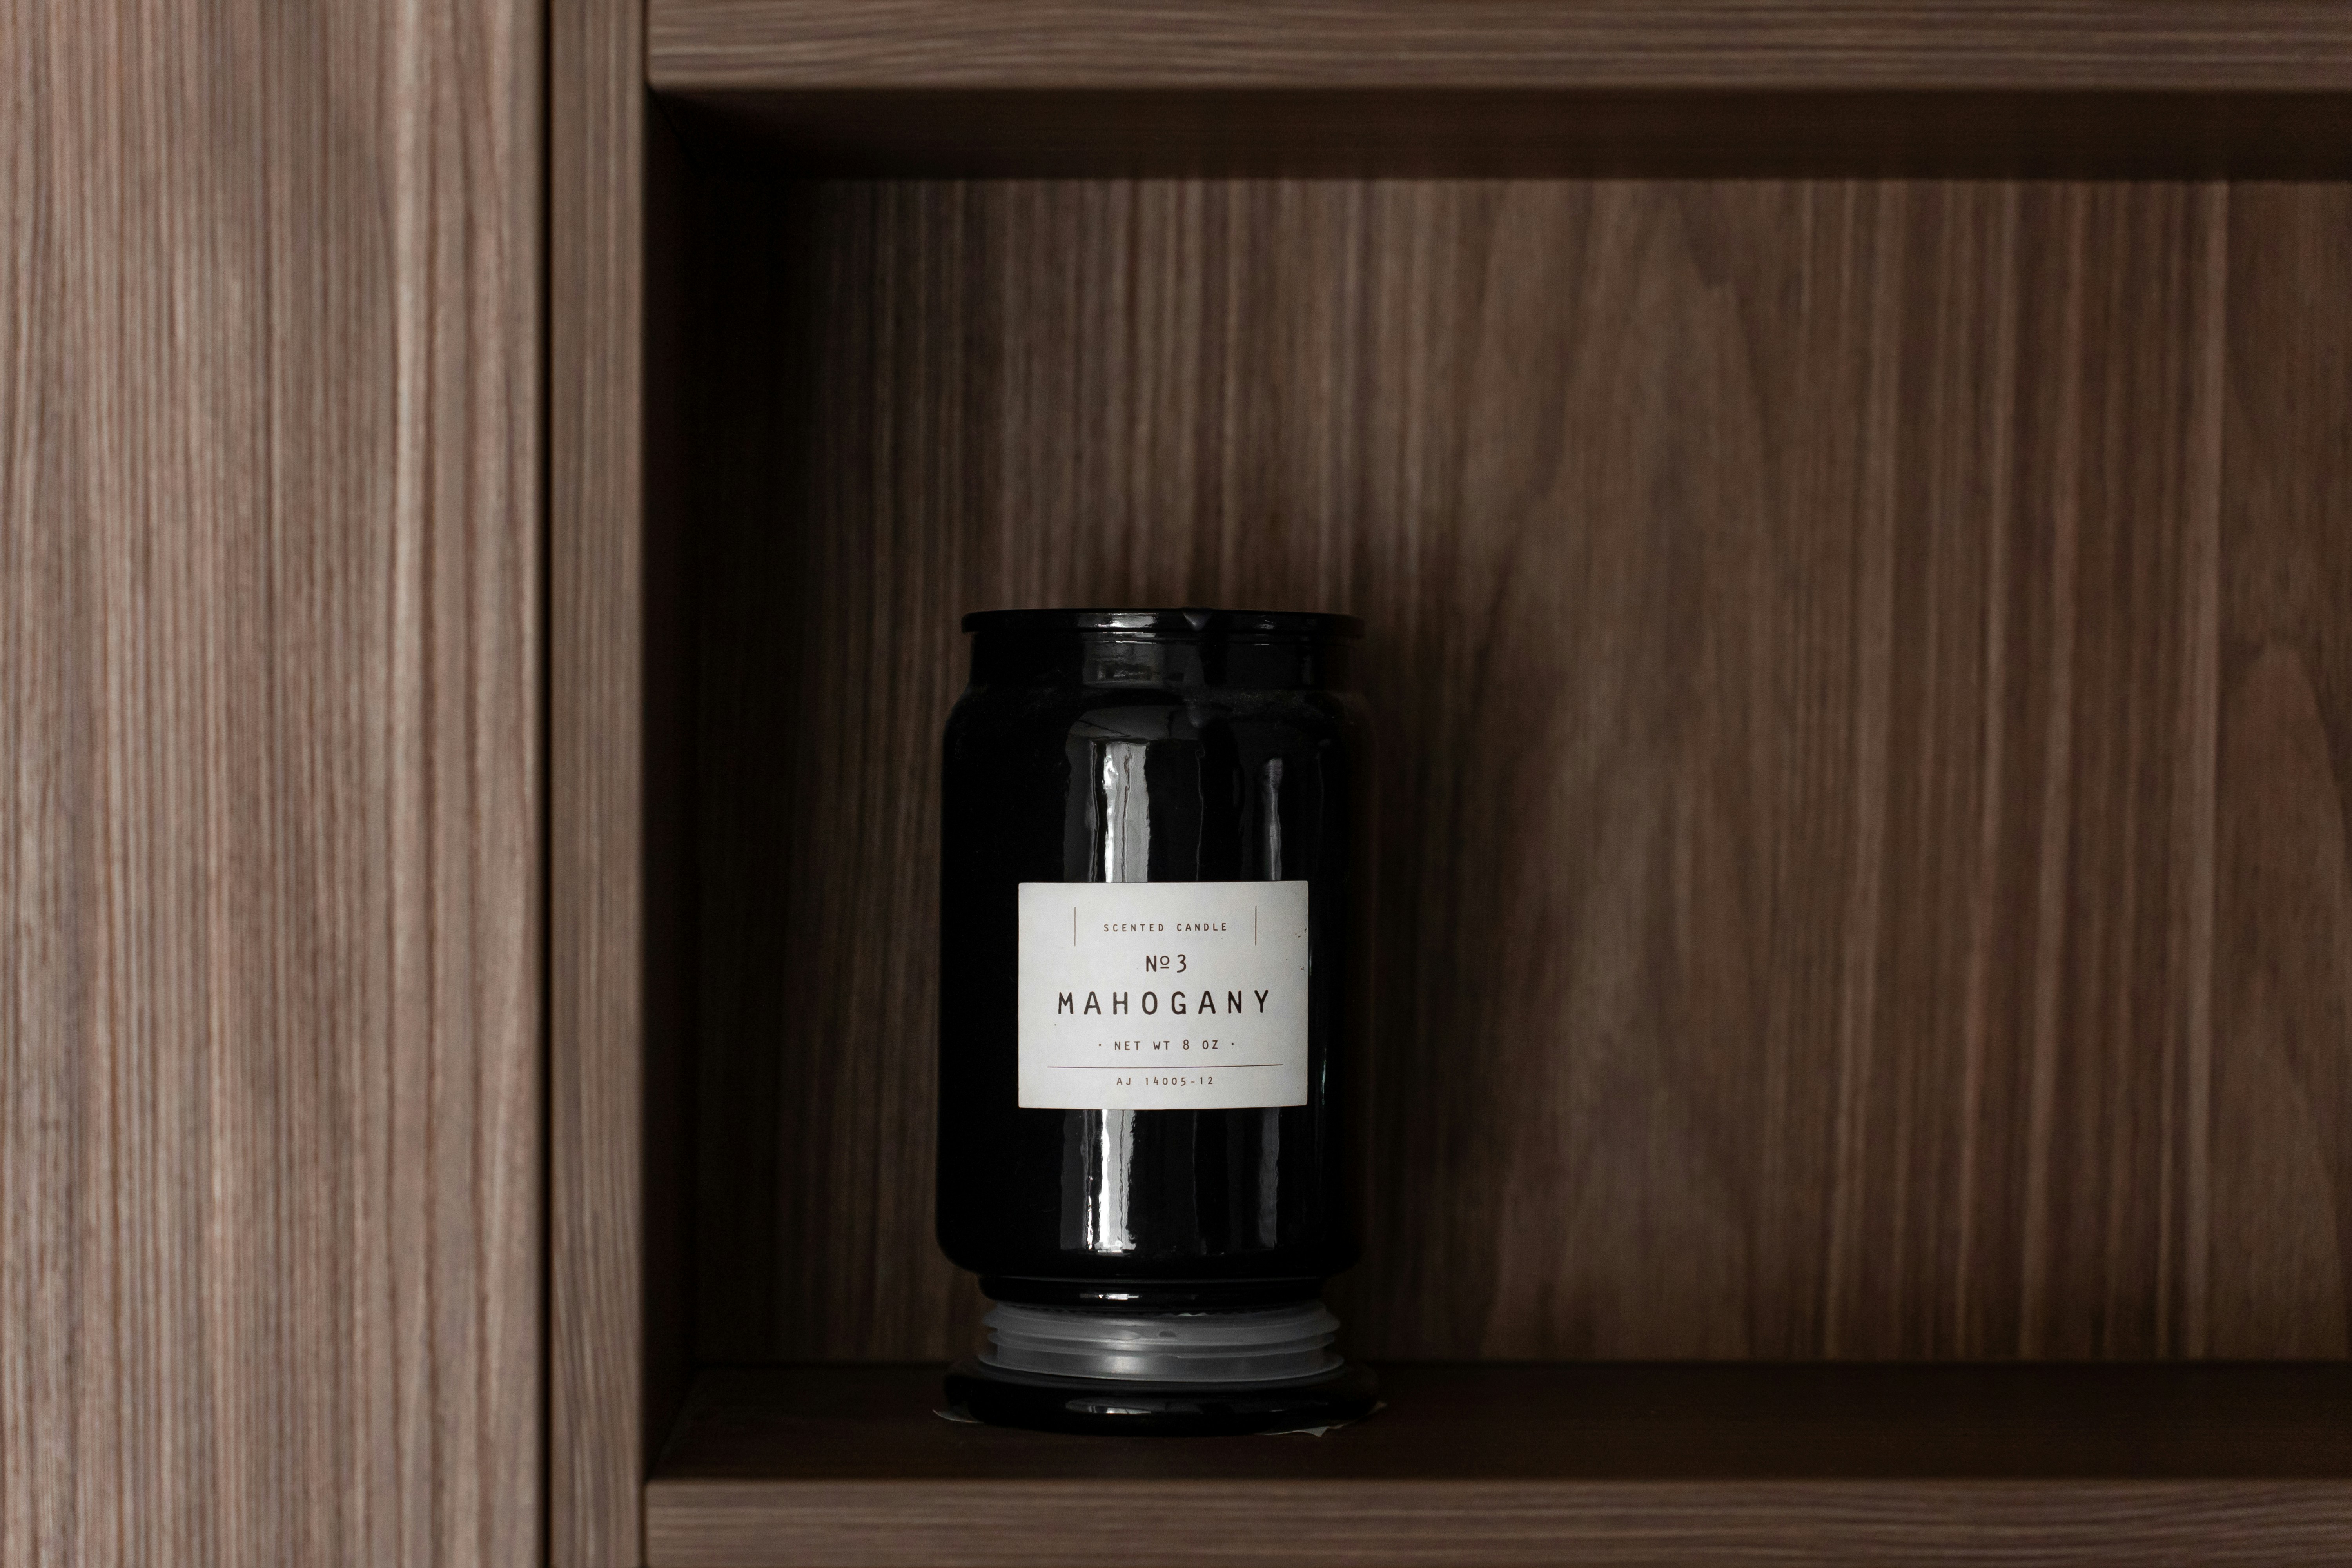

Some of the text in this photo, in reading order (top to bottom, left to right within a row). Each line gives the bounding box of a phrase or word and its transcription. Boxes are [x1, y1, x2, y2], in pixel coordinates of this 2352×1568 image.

[1104, 923, 1227, 932] SCENTED CANDLE
[1058, 989, 1269, 1016] MAHOGANY
[1114, 1039, 1218, 1051] NET WT 8 OZ
[1116, 1076, 1213, 1086] AJ 14005-12
